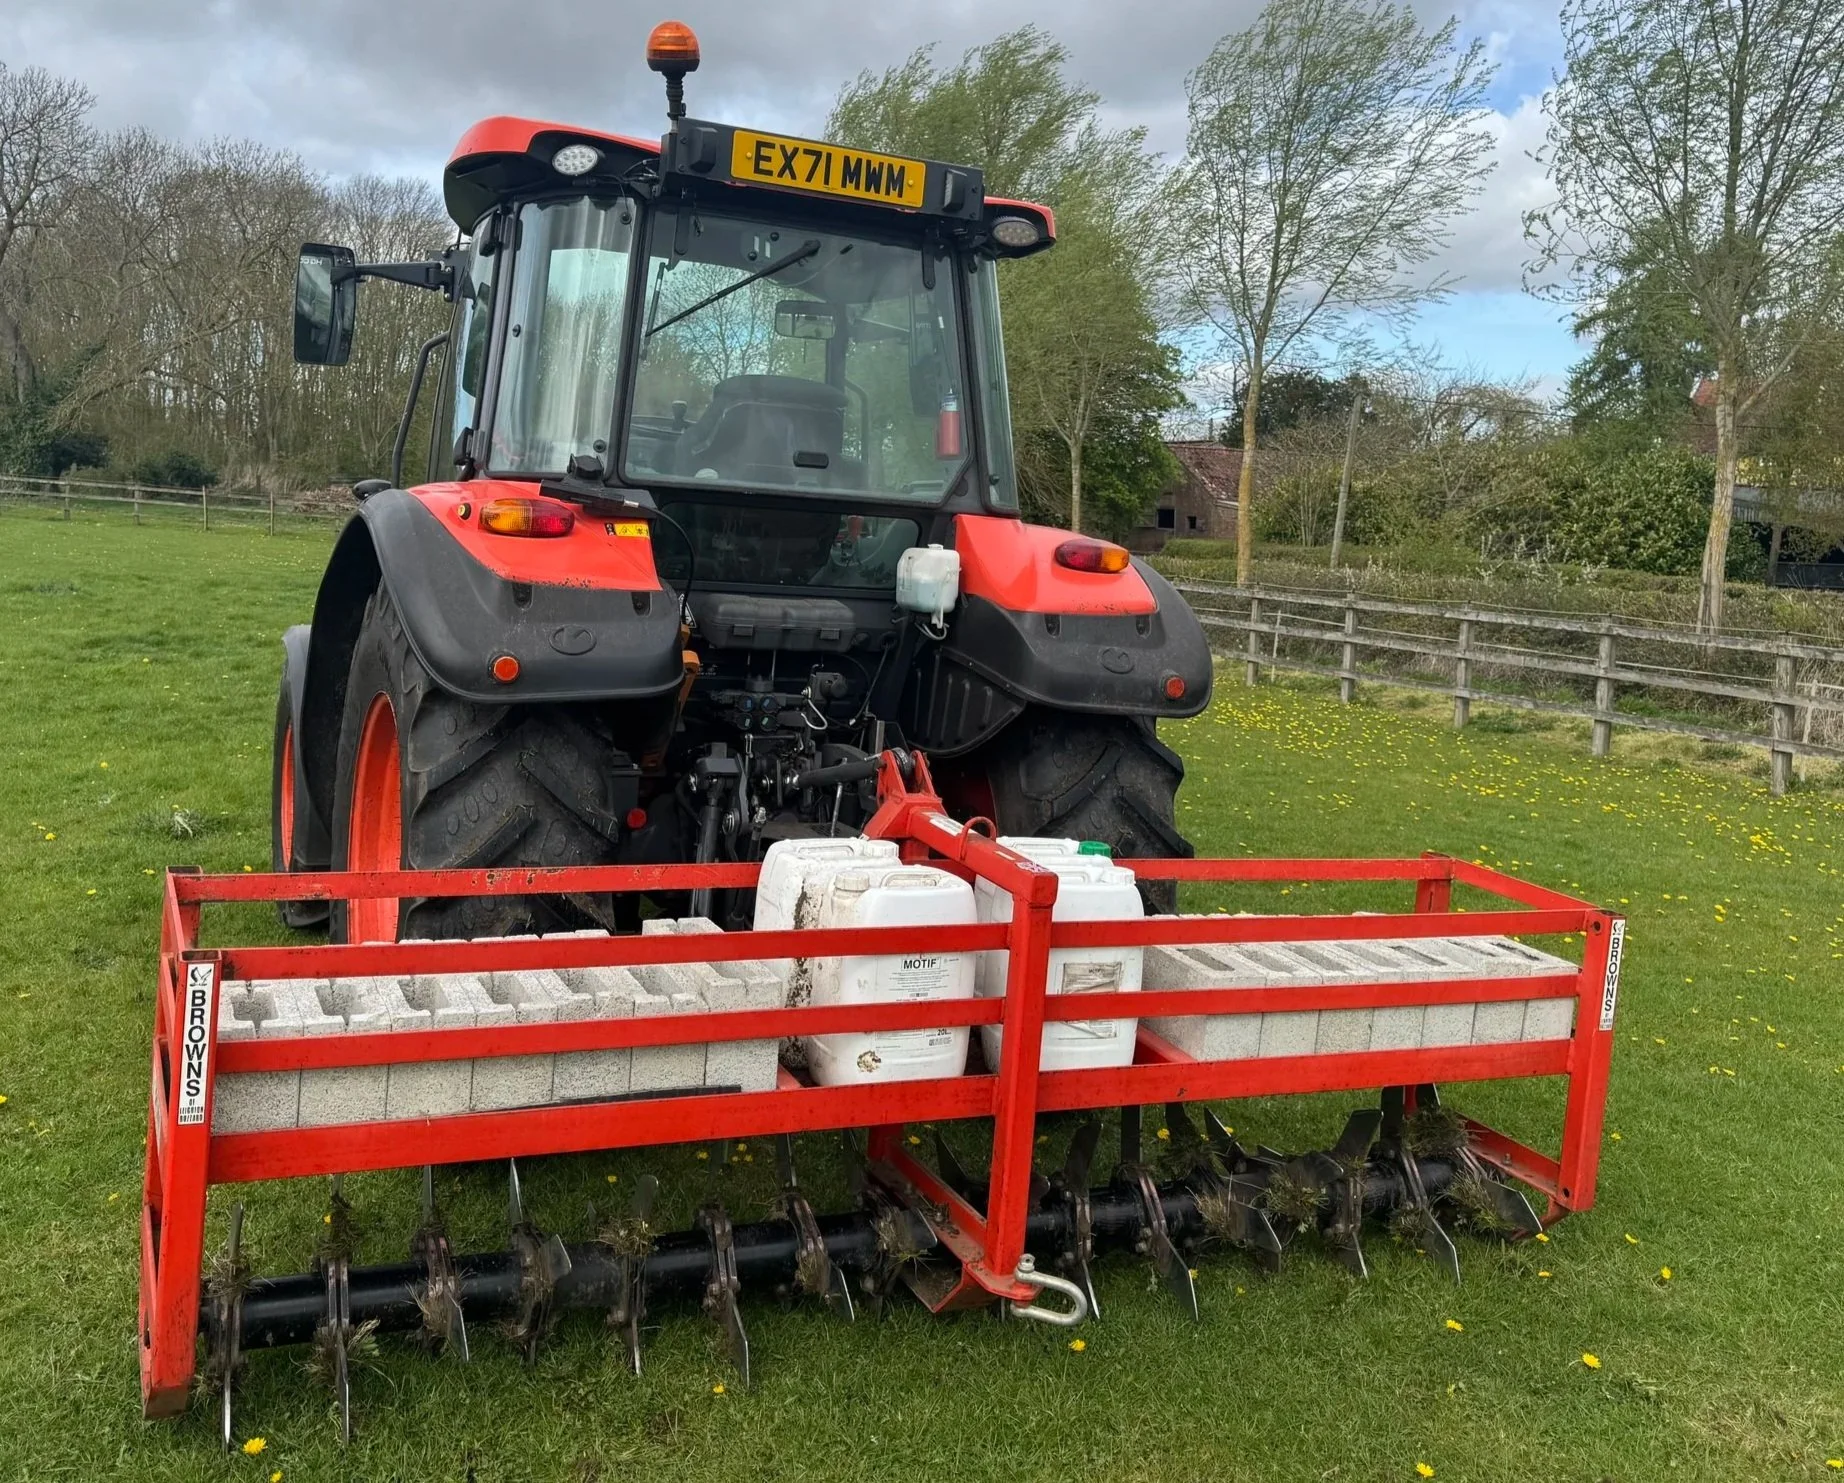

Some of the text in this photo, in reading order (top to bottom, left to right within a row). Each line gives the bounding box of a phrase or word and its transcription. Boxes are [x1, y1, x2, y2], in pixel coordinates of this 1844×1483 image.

[753, 140, 905, 198] EX71 MWM
[903, 958, 937, 970] MOTIF
[1604, 938, 1620, 1012] BROWNS
[185, 990, 207, 1097] BROWNS
